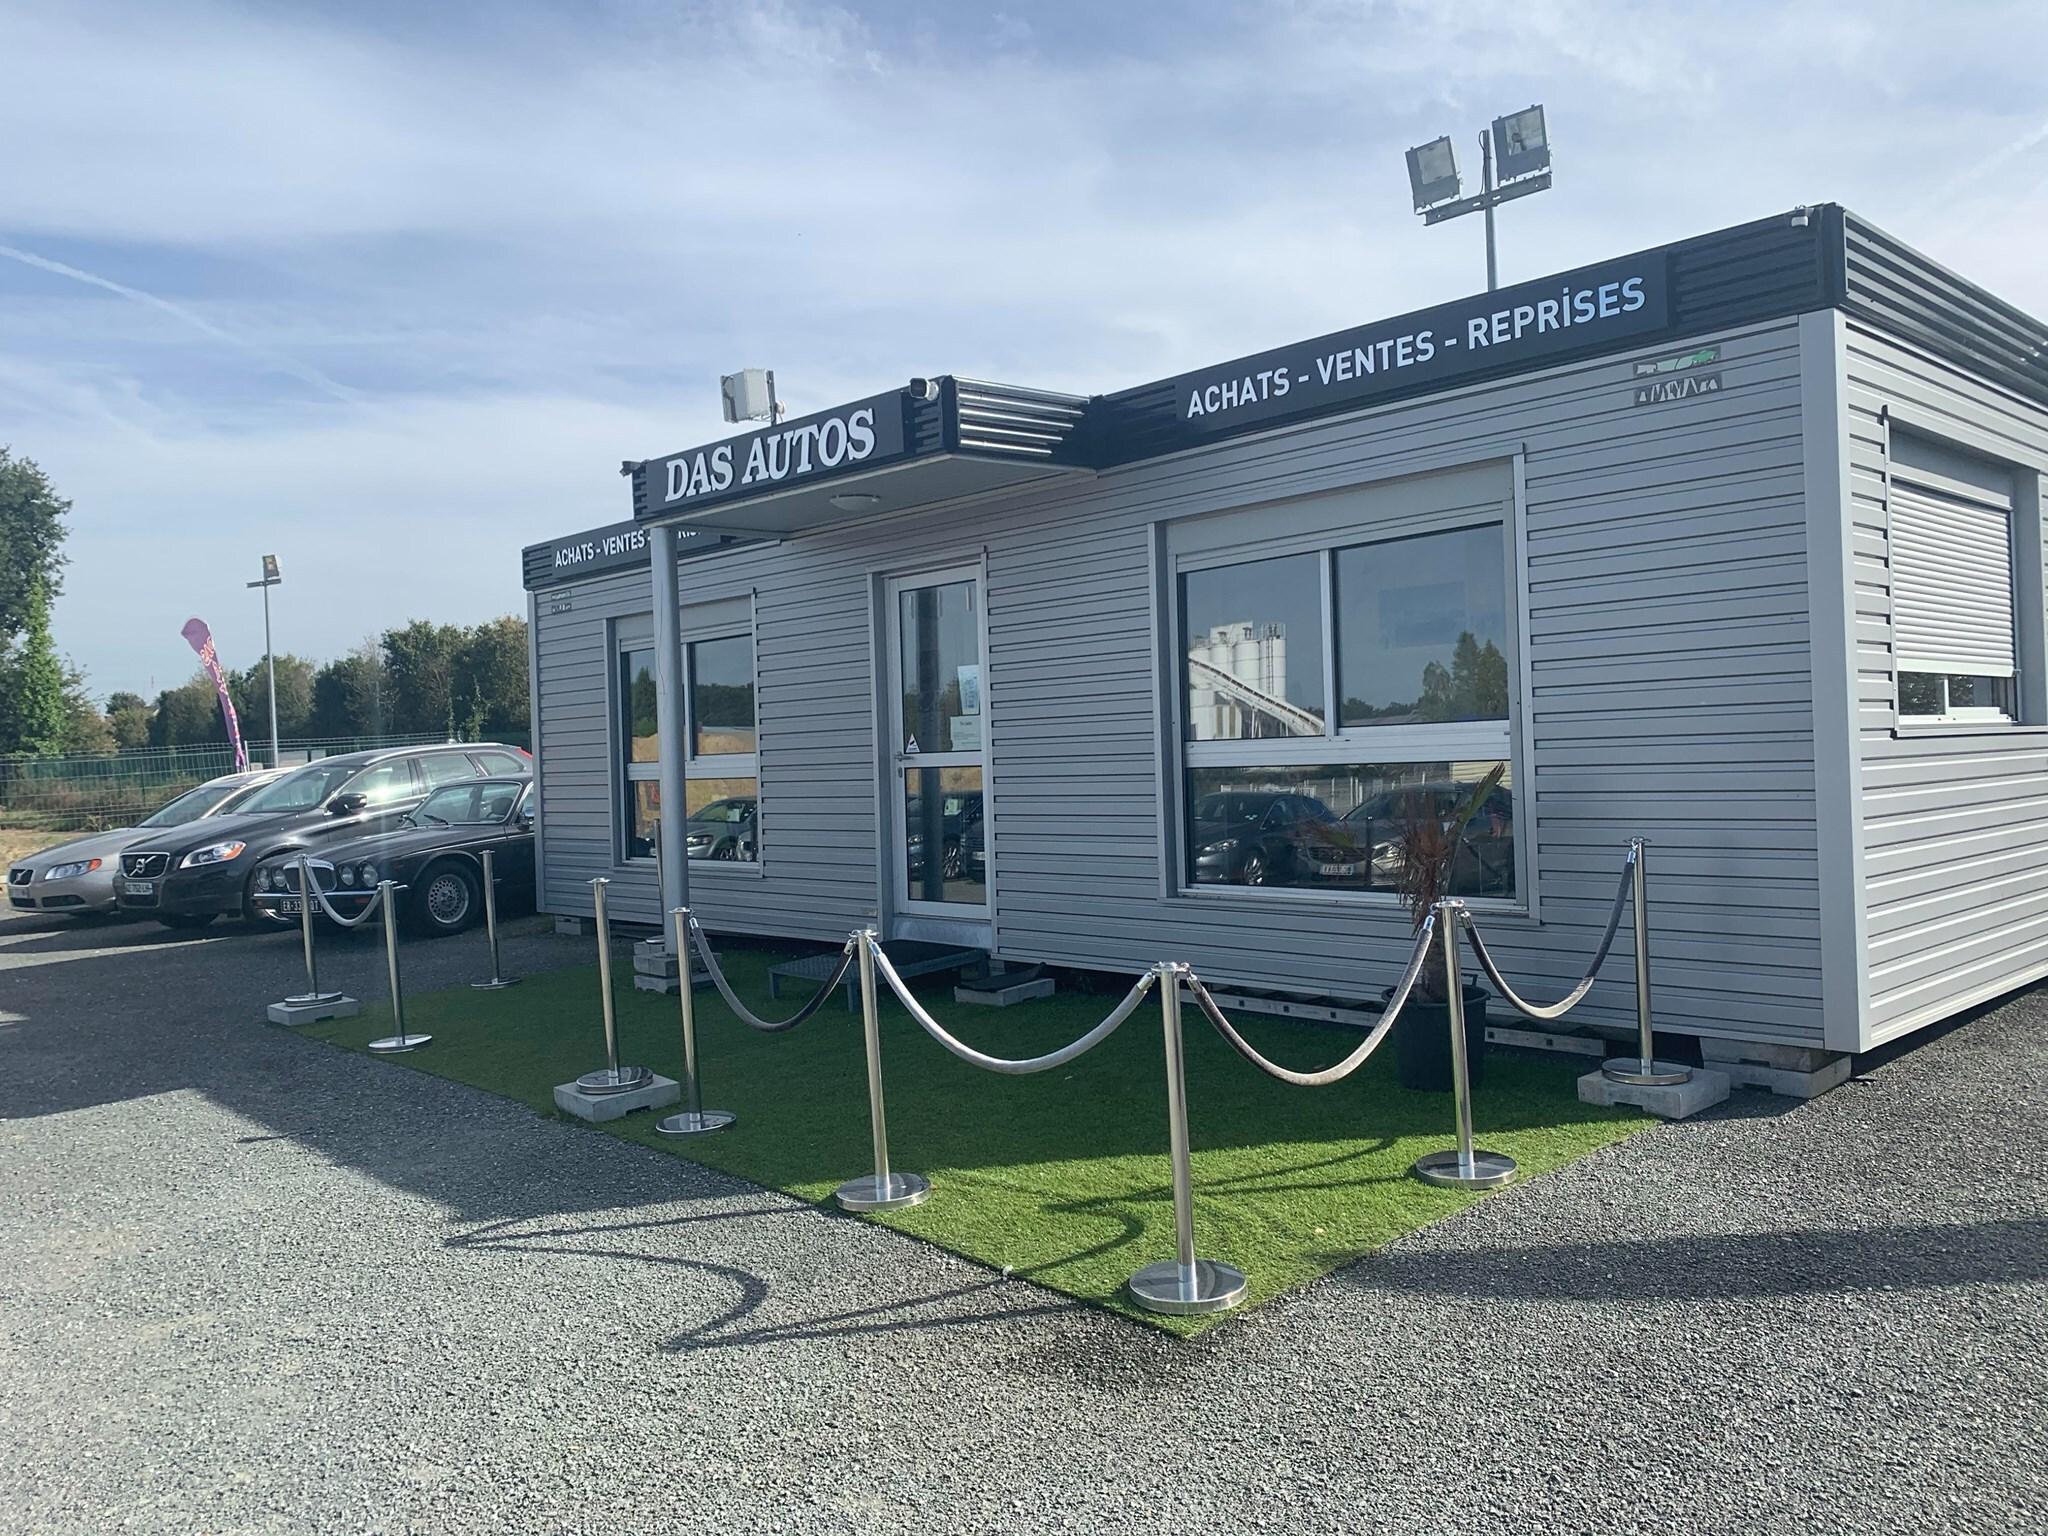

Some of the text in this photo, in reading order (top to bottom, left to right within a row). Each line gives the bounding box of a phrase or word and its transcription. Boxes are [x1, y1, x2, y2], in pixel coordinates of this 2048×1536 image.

[1188, 367, 1290, 418] ACHATS
[1315, 330, 1435, 385] VENTES
[664, 408, 875, 502] DAS AUTOS
[555, 543, 594, 568] ACHATS
[603, 529, 645, 556] VENTES
